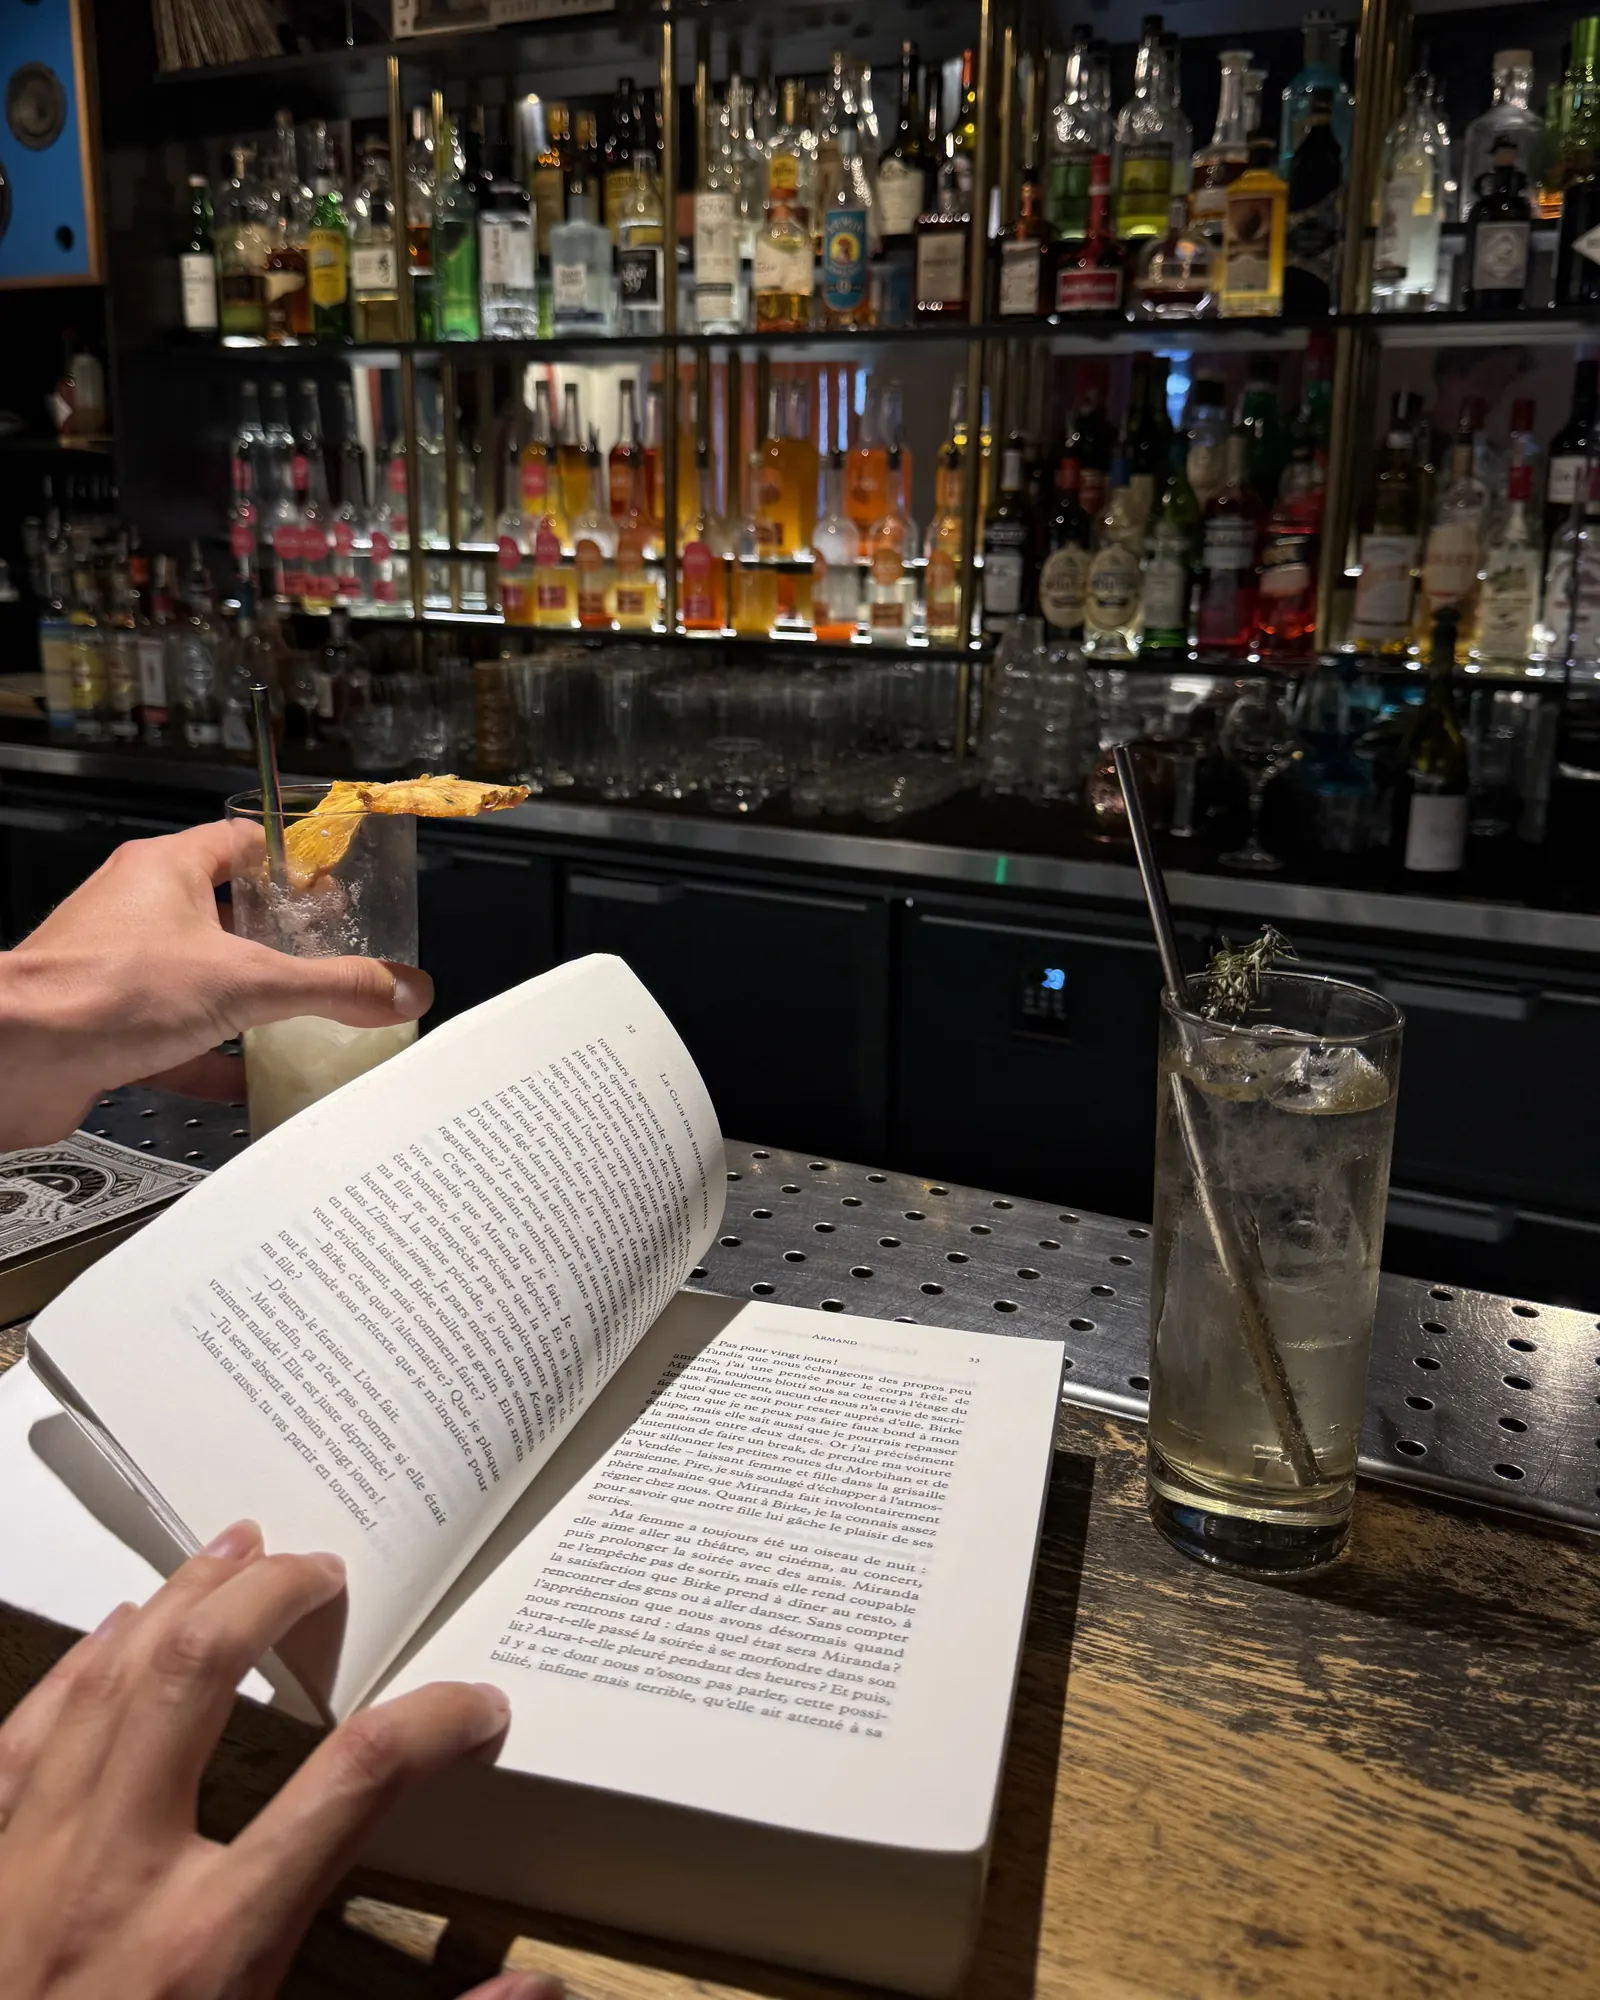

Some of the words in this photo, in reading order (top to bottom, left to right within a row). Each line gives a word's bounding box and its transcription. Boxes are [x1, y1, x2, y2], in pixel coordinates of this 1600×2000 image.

[625, 1024, 636, 1034] 32
[437, 1125, 476, 1162] regarder
[473, 1162, 496, 1186] mon
[494, 1186, 524, 1220] enfant
[260, 1242, 278, 1259] ma
[312, 1206, 334, 1231] veut,
[333, 1228, 390, 1290] évidemment,
[389, 1288, 415, 1314] mais
[413, 1314, 459, 1366] comment
[209, 1278, 249, 1322] vraiment
[281, 1356, 304, 1381] Elle
[302, 1381, 320, 1398] est
[313, 1394, 342, 1423] juste
[278, 1229, 299, 1250] tout
[295, 1246, 307, 1259] le
[305, 1258, 338, 1292] monde
[336, 1290, 360, 1314] sous
[354, 1312, 397, 1355] prétexte
[395, 1355, 416, 1377] que
[411, 1375, 426, 1389] je
[467, 1458, 488, 1492] pour
[811, 1333, 858, 1346] ARMAND
[968, 1356, 980, 1364] 33
[196, 1330, 223, 1359] Mais
[219, 1357, 239, 1373] toi
[232, 1372, 262, 1403] aussi,
[258, 1399, 273, 1415] tu
[271, 1413, 289, 1433] vas
[283, 1431, 318, 1463] partir
[314, 1464, 331, 1480] en
[216, 1316, 232, 1336] Tu
[228, 1333, 254, 1360] seras
[251, 1358, 284, 1393] absent
[280, 1391, 296, 1406] au
[293, 1405, 326, 1439] moins
[324, 1437, 353, 1469] vingt
[250, 1291, 276, 1319] Mais
[275, 1319, 301, 1350] enfin,
[300, 1348, 317, 1363] ça
[335, 1387, 359, 1408] pas
[357, 1409, 396, 1452] comme
[394, 1453, 410, 1466] si
[405, 1467, 425, 1491] elle
[424, 1493, 446, 1526] était
[606, 1459, 644, 1471] phère
[647, 1466, 704, 1482] malsaine
[707, 1477, 733, 1487] que
[735, 1481, 794, 1499] Miranda
[797, 1492, 820, 1503] fait
[824, 1496, 940, 1524] involontairement
[620, 1437, 632, 1445] la
[638, 1439, 682, 1453] Vendée
[696, 1449, 744, 1465] laissant
[747, 1459, 792, 1474] femme
[812, 1471, 837, 1482] fille
[841, 1476, 872, 1488] dans
[876, 1482, 888, 1491] la
[892, 1486, 946, 1500] grisaille
[626, 1428, 658, 1438] pour
[659, 1432, 715, 1447] sillonner
[716, 1441, 734, 1451] les
[735, 1447, 778, 1460] petites
[781, 1455, 821, 1468] routes
[824, 1462, 842, 1471] du
[845, 1465, 912, 1483] Morbihan
[932, 1480, 949, 1489] de
[587, 1493, 633, 1507] sorties.
[592, 1482, 627, 1492] pour
[628, 1488, 668, 1500] savoir
[669, 1495, 695, 1505] que
[697, 1500, 734, 1512] notre
[736, 1505, 762, 1517] fille
[764, 1511, 784, 1522] lui
[785, 1516, 826, 1529] gâche
[828, 1522, 842, 1532] le
[843, 1527, 889, 1540] plaisir
[891, 1534, 909, 1544] de
[912, 1539, 933, 1548] ses
[600, 1470, 644, 1483] régner
[645, 1477, 675, 1489] chez
[676, 1484, 711, 1496] nous.
[715, 1489, 758, 1504] Quant
[760, 1497, 768, 1506] à
[771, 1499, 811, 1515] Birke,
[813, 1507, 827, 1517] je
[829, 1510, 842, 1520] la
[845, 1515, 898, 1529] connais
[900, 1525, 937, 1536] assez
[563, 1529, 595, 1540] puis
[598, 1535, 669, 1553] prolonger
[672, 1546, 686, 1556] la
[691, 1552, 734, 1566] soirée
[738, 1561, 772, 1573] avec
[776, 1567, 801, 1579] des
[806, 1574, 846, 1587] amis.
[852, 1580, 919, 1601] Miranda
[573, 1516, 597, 1526] elle
[600, 1521, 635, 1533] aime
[638, 1528, 671, 1539] aller
[673, 1535, 691, 1544] au
[696, 1538, 749, 1556] théâtre,
[755, 1550, 773, 1559] au
[778, 1554, 834, 1572] cinéma,
[839, 1566, 858, 1575] au
[863, 1571, 922, 1588] concert,
[541, 1567, 617, 1586] rencontrer
[617, 1579, 642, 1591] des
[643, 1586, 678, 1599] gens
[680, 1593, 699, 1603] ou
[701, 1595, 711, 1605] à
[713, 1599, 747, 1612] aller
[749, 1605, 802, 1623] danser.
[806, 1616, 842, 1631] Sans
[845, 1626, 909, 1643] compter
[549, 1552, 563, 1562] la
[566, 1557, 646, 1577] satisfaction
[650, 1573, 678, 1583] que
[681, 1576, 721, 1592] Birke
[724, 1587, 769, 1602] prend
[773, 1594, 782, 1604] à
[787, 1598, 828, 1613] dîner
[831, 1608, 850, 1617] au
[855, 1612, 897, 1627] resto,
[902, 1618, 912, 1628] à
